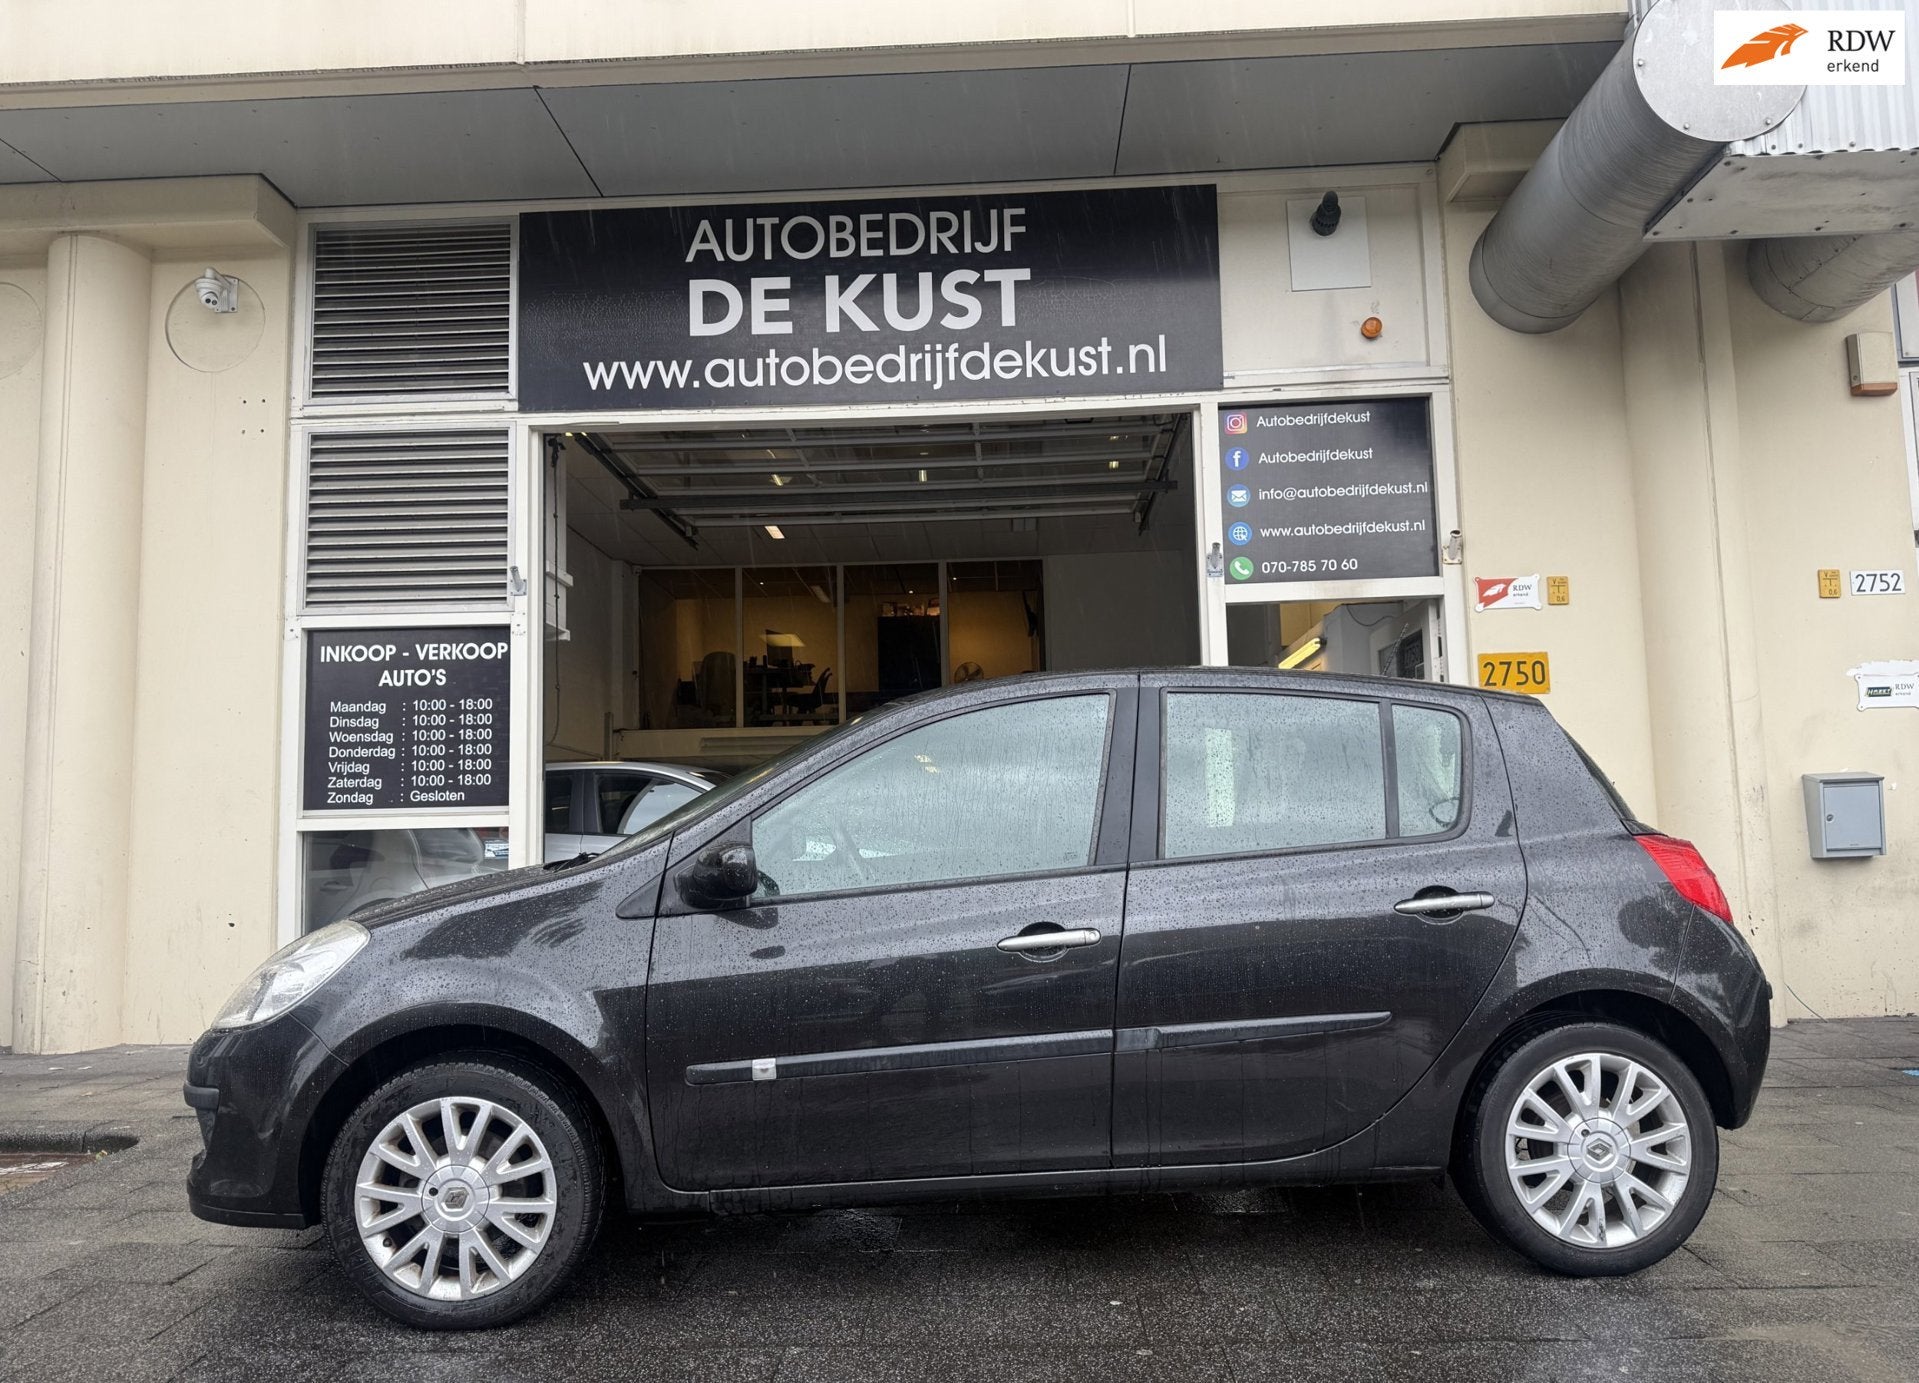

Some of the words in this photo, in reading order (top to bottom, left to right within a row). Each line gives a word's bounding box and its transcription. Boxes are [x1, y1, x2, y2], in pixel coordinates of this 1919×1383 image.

[685, 208, 1026, 262] AUTOBEDRIJF
[689, 276, 793, 337] DE
[825, 267, 1032, 333] KUST
[583, 334, 1167, 391] www.autobedrijfdekust.nl
[1256, 411, 1371, 428] Autobedrijfdekust
[1258, 447, 1373, 464] Autobedrijfdekust
[1258, 481, 1428, 501] info@autobedrijfdekust.nl
[1259, 519, 1426, 538] www.autobedrijfdekust.nl
[1261, 560, 1317, 574] 070-785
[1320, 559, 1338, 571] 70
[1340, 558, 1358, 571] 60
[1512, 584, 1533, 592] RDW
[1855, 572, 1902, 593] 2752
[320, 644, 397, 663] INKOOP
[415, 642, 509, 661] VERKOOP
[378, 668, 447, 687] AUTO'S
[1483, 660, 1546, 687] 2750
[330, 700, 387, 715] Maandag
[412, 698, 447, 711] 10:00
[458, 698, 493, 711] 18:00
[329, 715, 379, 730] Dinsdag
[412, 713, 447, 726] 10:00
[458, 712, 493, 726] 18:00
[328, 730, 394, 745] Woensdag
[412, 729, 446, 741] 10:00
[458, 728, 493, 741] 18:00
[328, 745, 396, 760] Donderdag
[411, 744, 446, 757] 10:00
[458, 743, 492, 756] 18:00
[328, 761, 370, 776] Vrijdag
[411, 759, 446, 772] 10:00
[457, 758, 492, 771] 18:00
[327, 776, 382, 791] Zaterdag
[411, 774, 445, 787] 10:00
[457, 773, 492, 786] 18:00
[326, 791, 374, 806] Zondag
[409, 789, 465, 802] Gesloten
